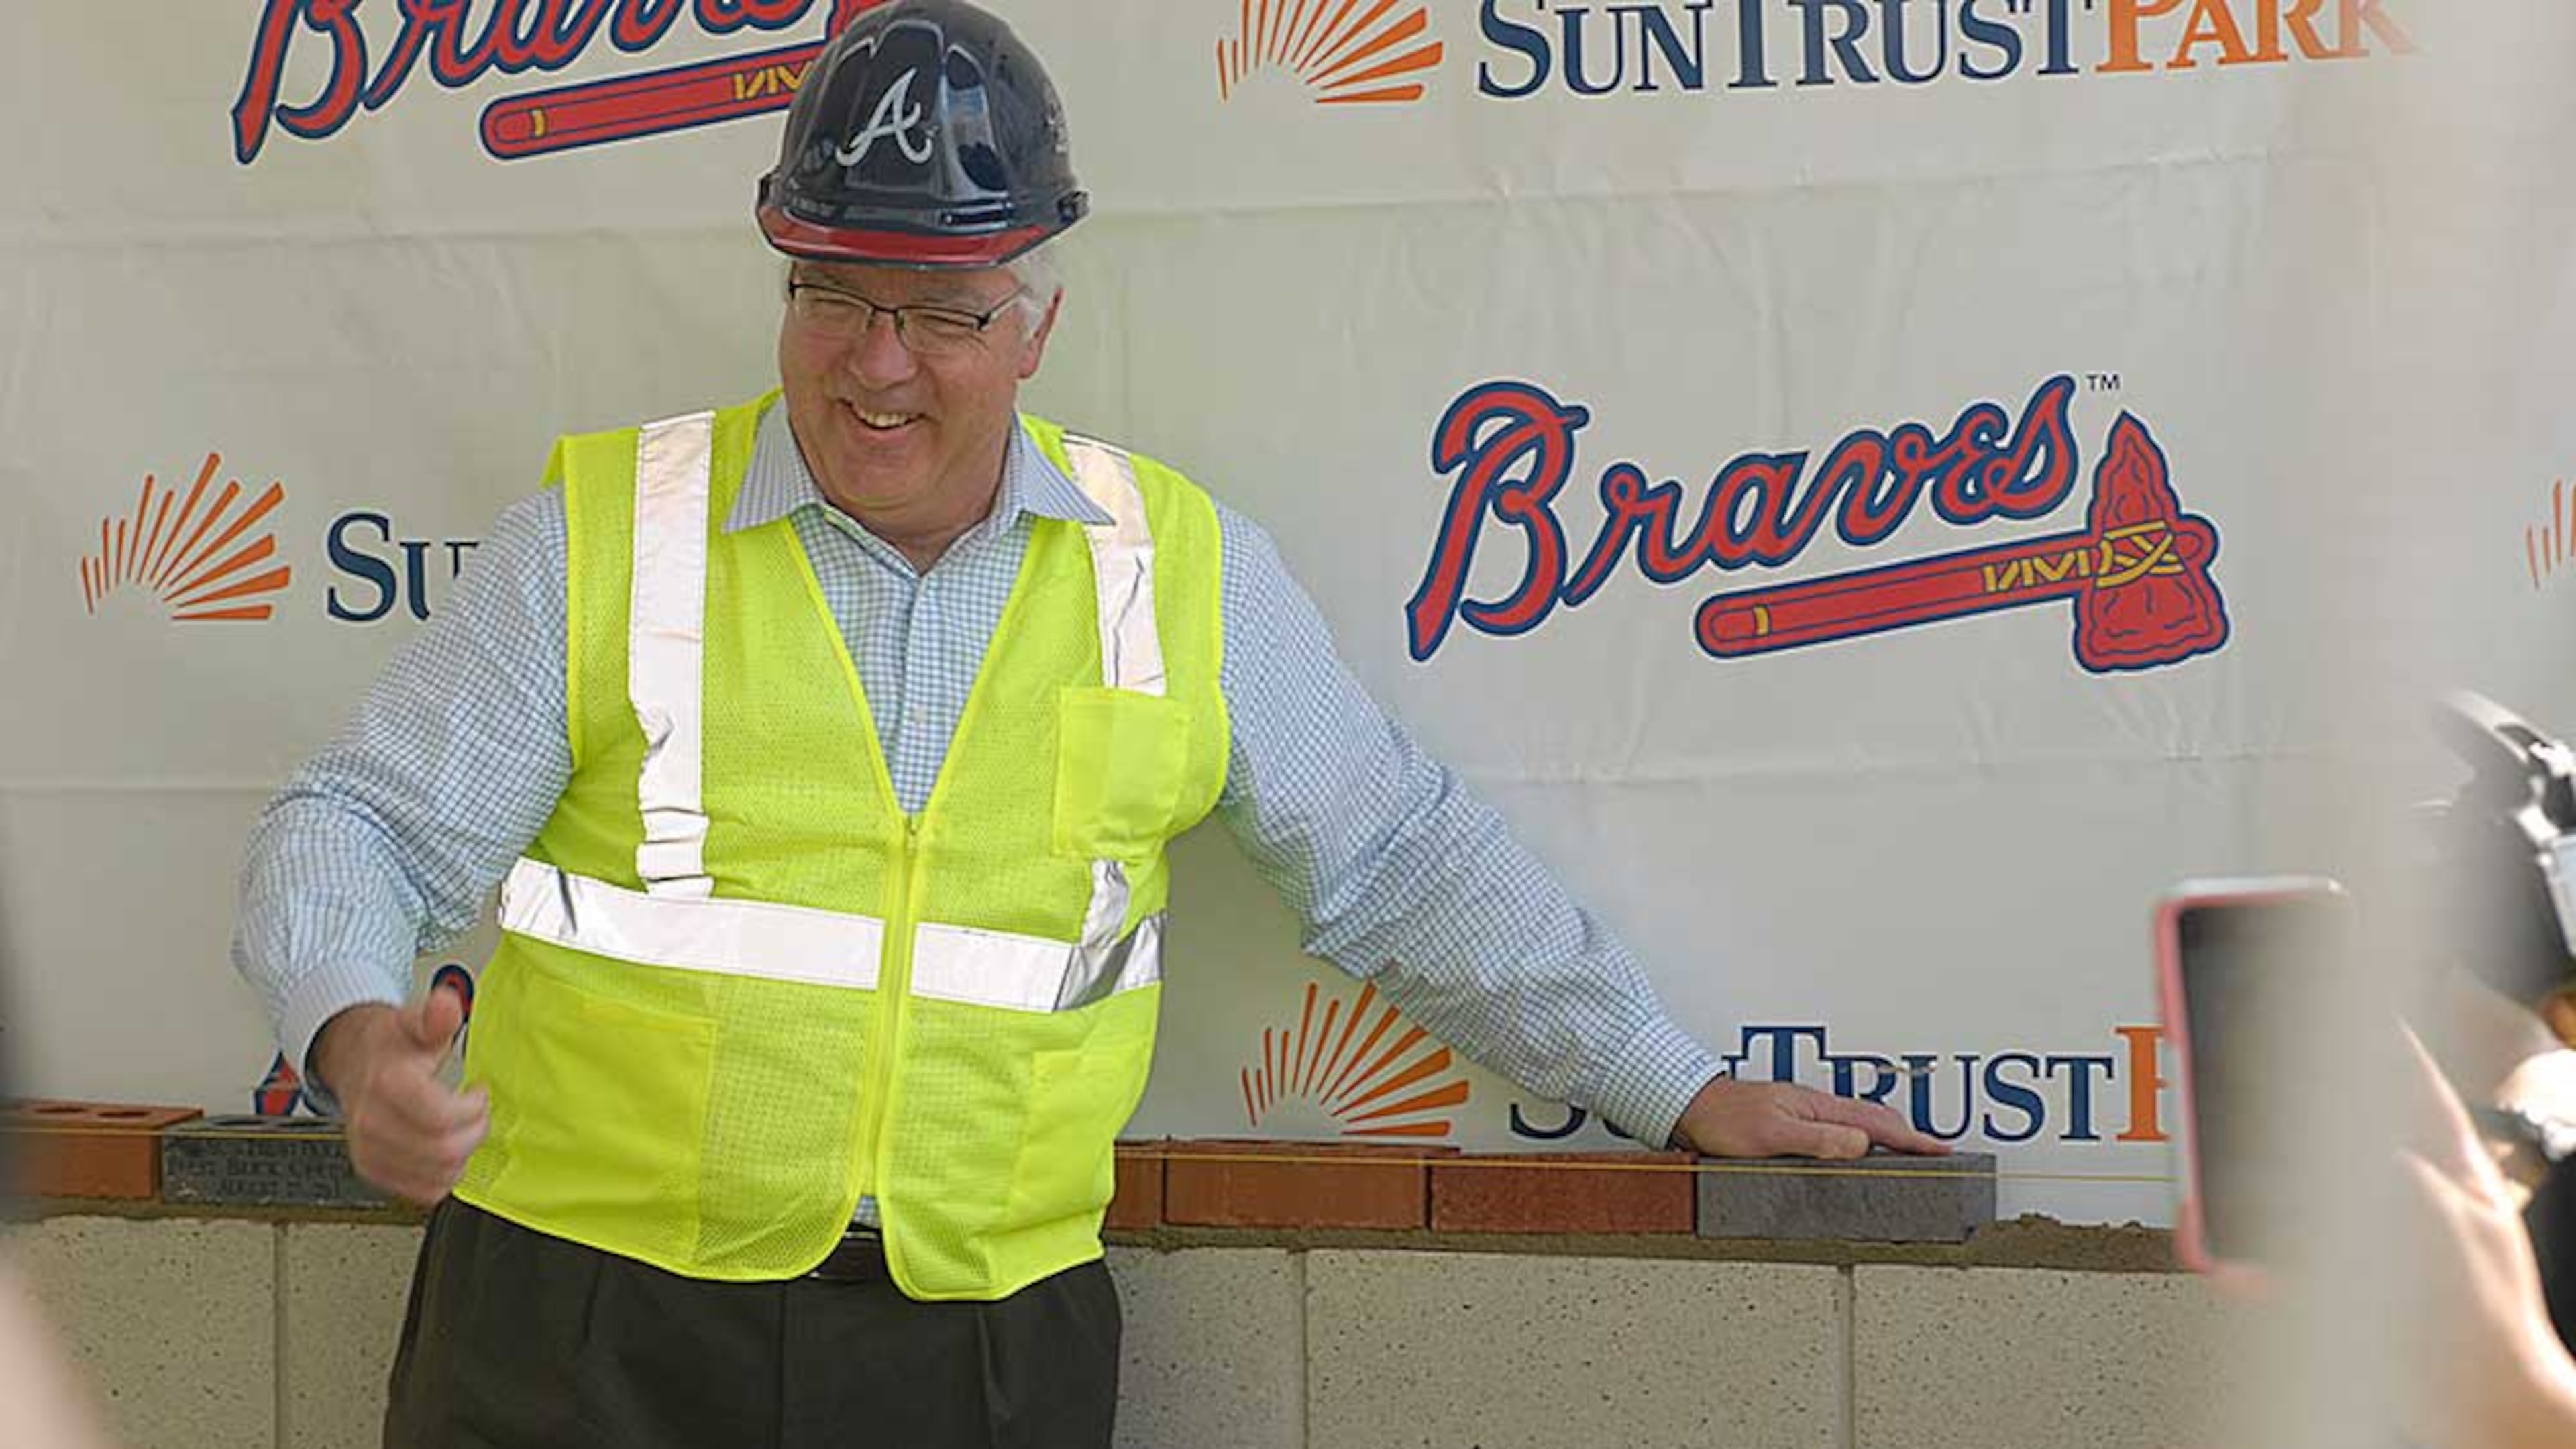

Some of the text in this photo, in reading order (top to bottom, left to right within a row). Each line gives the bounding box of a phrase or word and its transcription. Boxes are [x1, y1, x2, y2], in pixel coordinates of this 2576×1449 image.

[836, 68, 932, 166] A
[327, 513, 479, 621] SU
[1405, 374, 2120, 661] Braves TM
